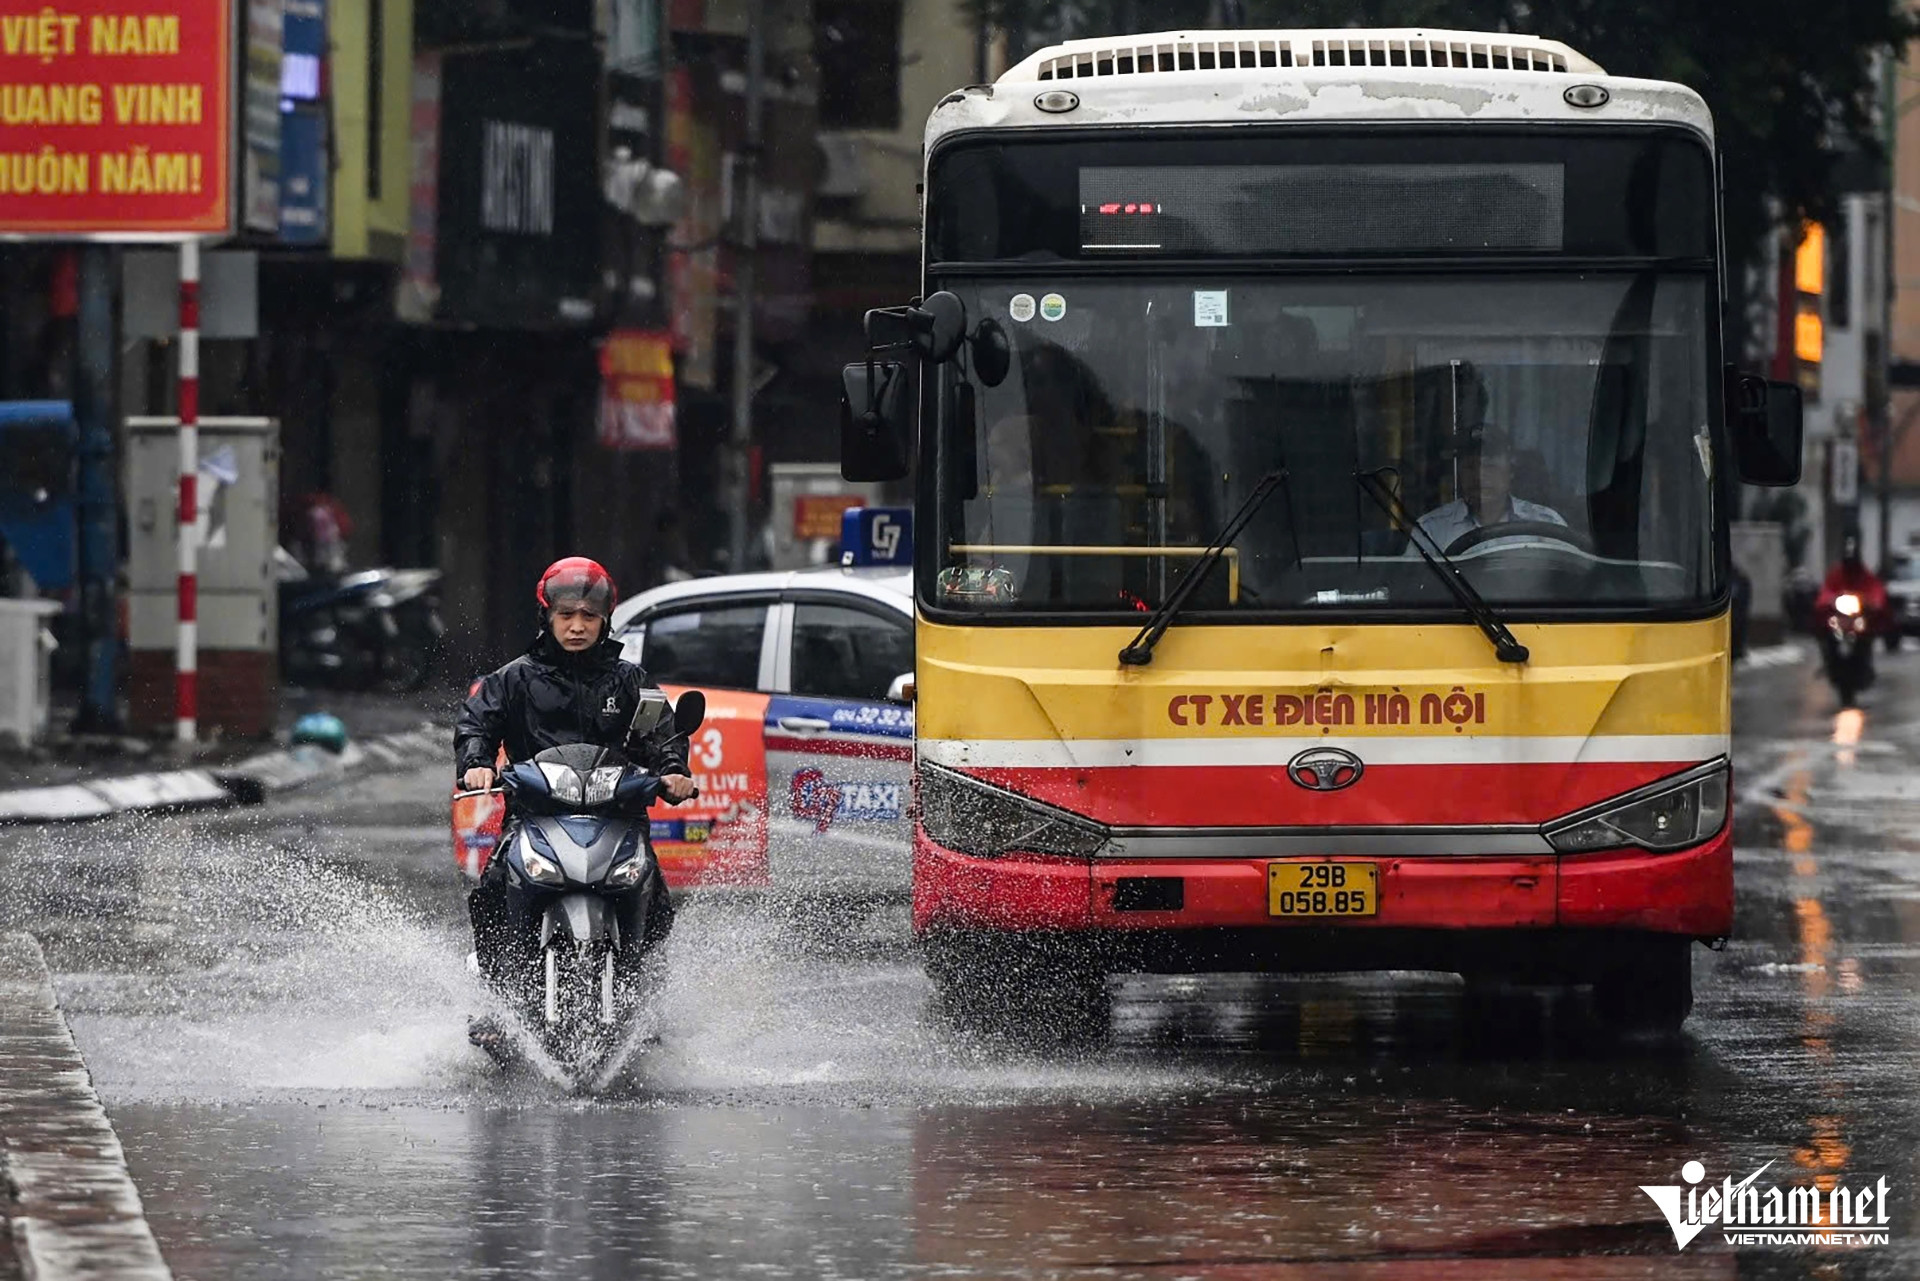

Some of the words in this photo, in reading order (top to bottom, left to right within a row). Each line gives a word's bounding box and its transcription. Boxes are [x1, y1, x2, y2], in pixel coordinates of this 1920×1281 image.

[2, 6, 81, 63] VIỆT
[90, 15, 179, 54] NAM
[0, 84, 101, 124] UANG
[113, 84, 202, 124] VINH
[99, 145, 202, 193] NĂM!
[1168, 694, 1213, 725] CT
[1220, 694, 1264, 725] XE
[1273, 687, 1355, 735] ĐIỆN
[1365, 686, 1410, 725] HÀ
[1420, 686, 1485, 733] NỘI
[712, 773, 748, 790] LIVE
[841, 784, 899, 810] TAXI
[1300, 865, 1345, 888] 29B
[1280, 891, 1365, 913] 058.85
